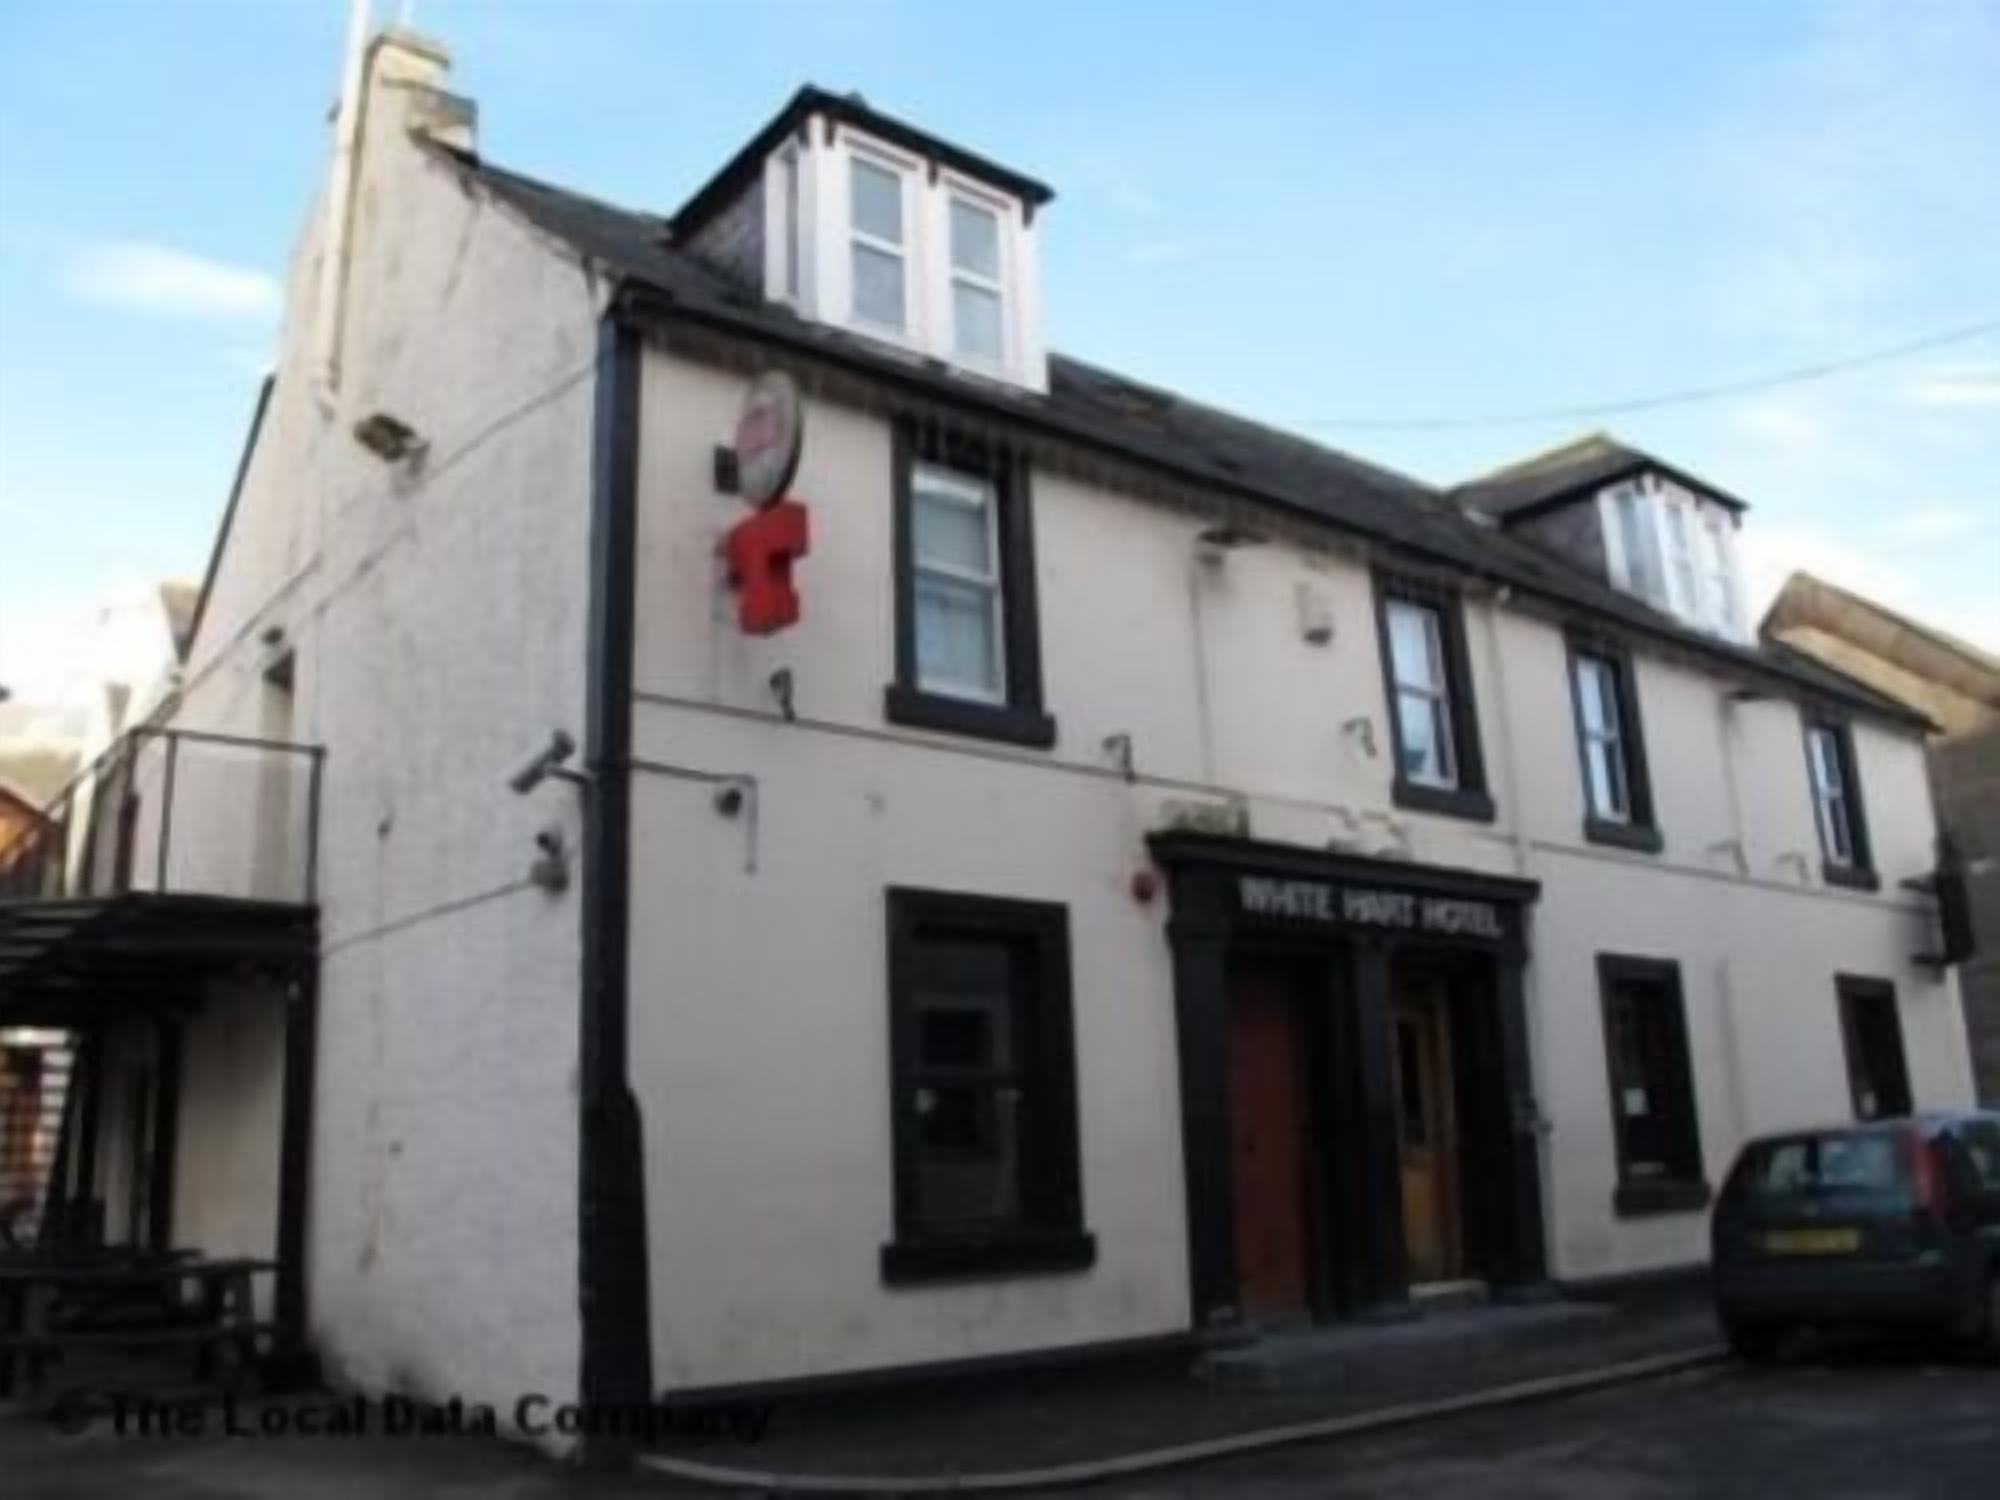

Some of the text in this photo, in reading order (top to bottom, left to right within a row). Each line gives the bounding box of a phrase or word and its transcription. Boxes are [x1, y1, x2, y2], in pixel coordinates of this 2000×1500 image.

[1239, 876, 1504, 939] WHITE HART HOTEL
